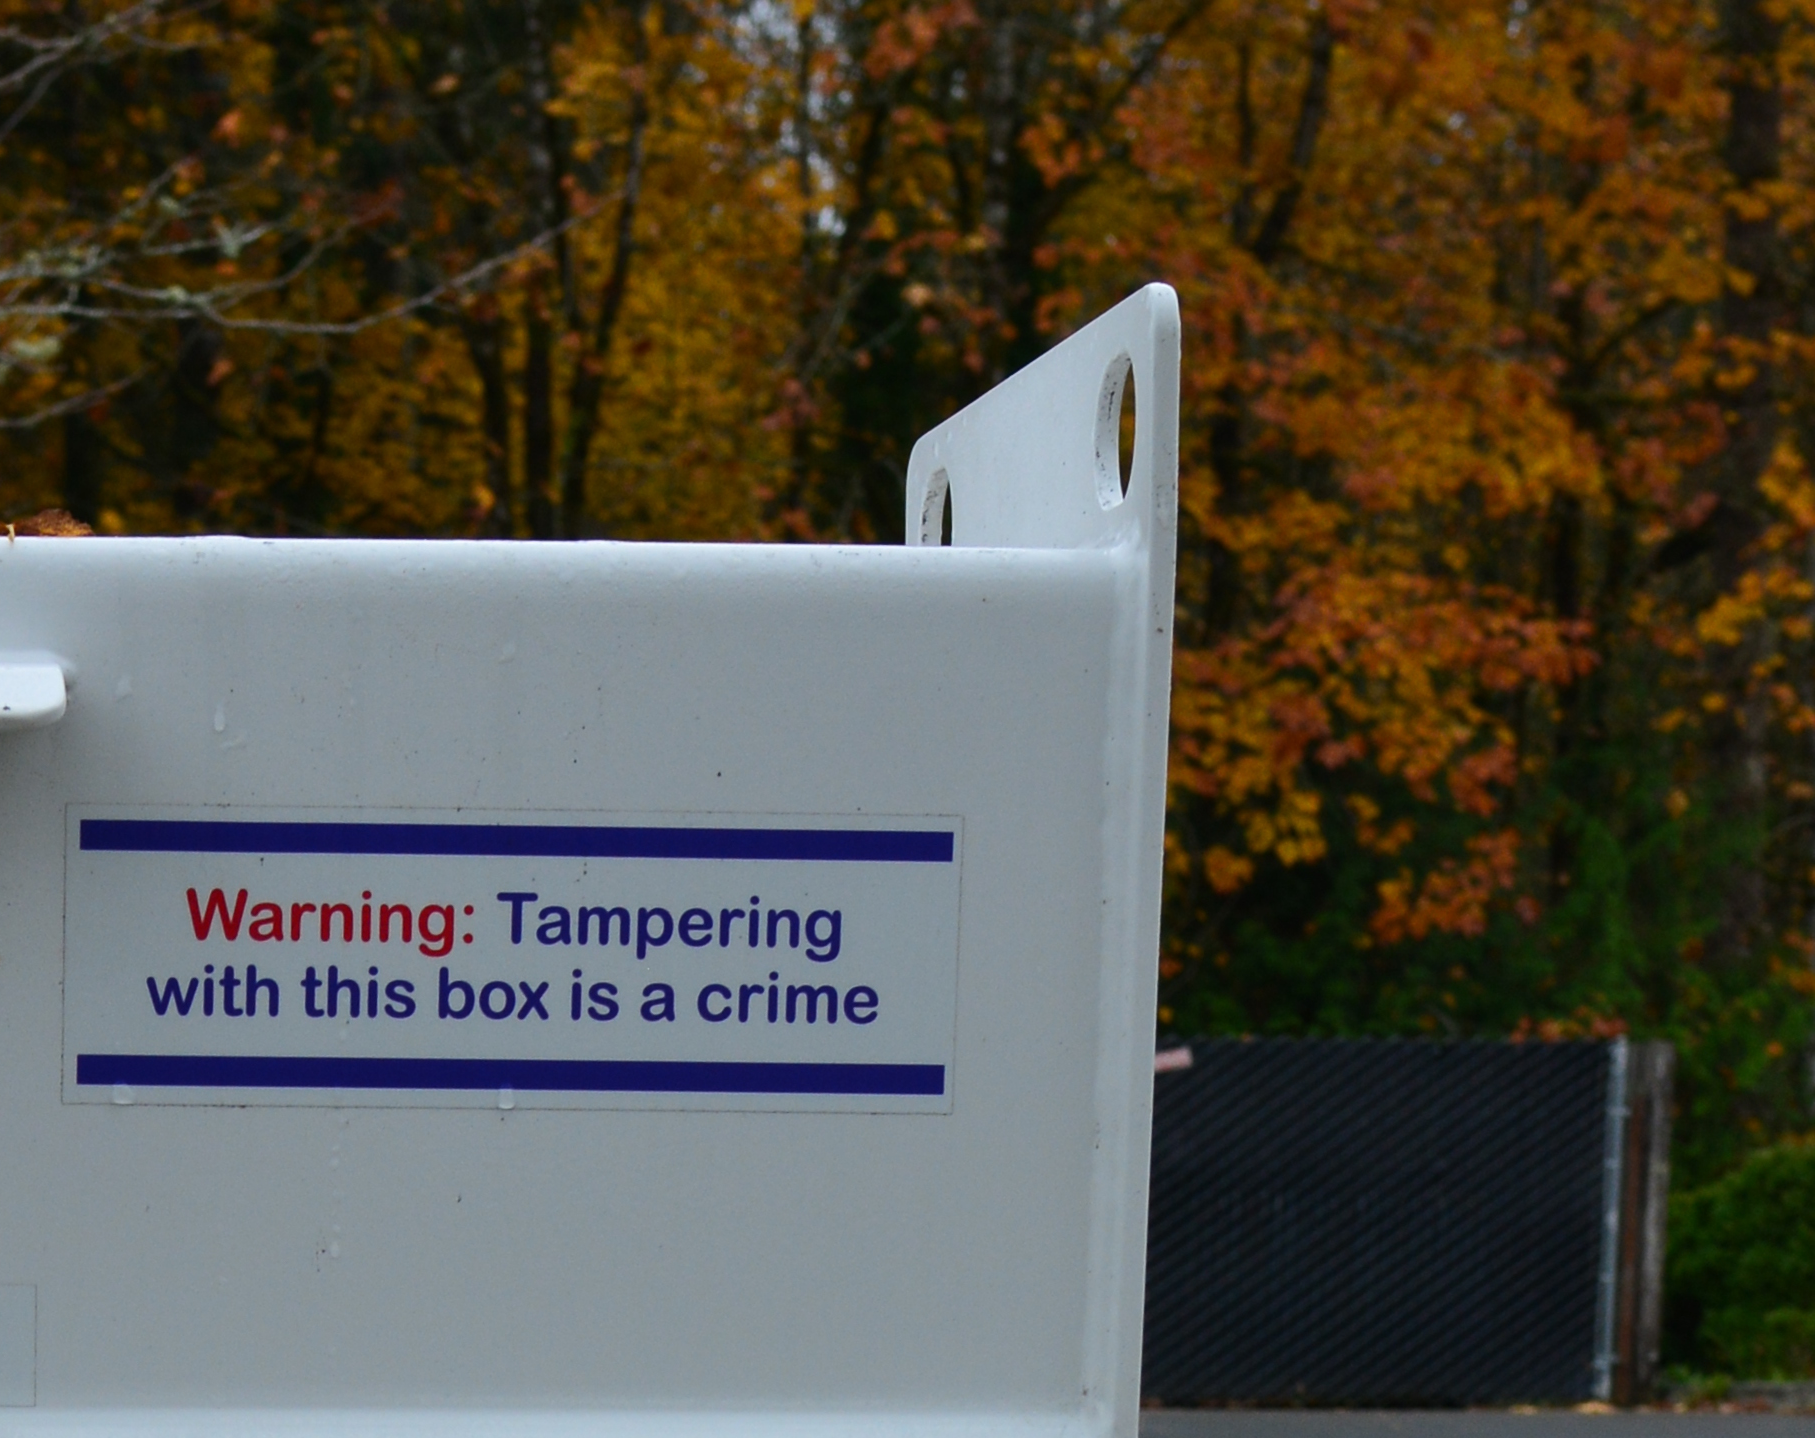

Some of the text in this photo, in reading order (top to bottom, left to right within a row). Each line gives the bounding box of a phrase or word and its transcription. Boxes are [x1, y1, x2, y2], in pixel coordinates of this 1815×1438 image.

[186, 888, 841, 962] Warning: Tampering
[146, 964, 878, 1024] with this box is a crime
